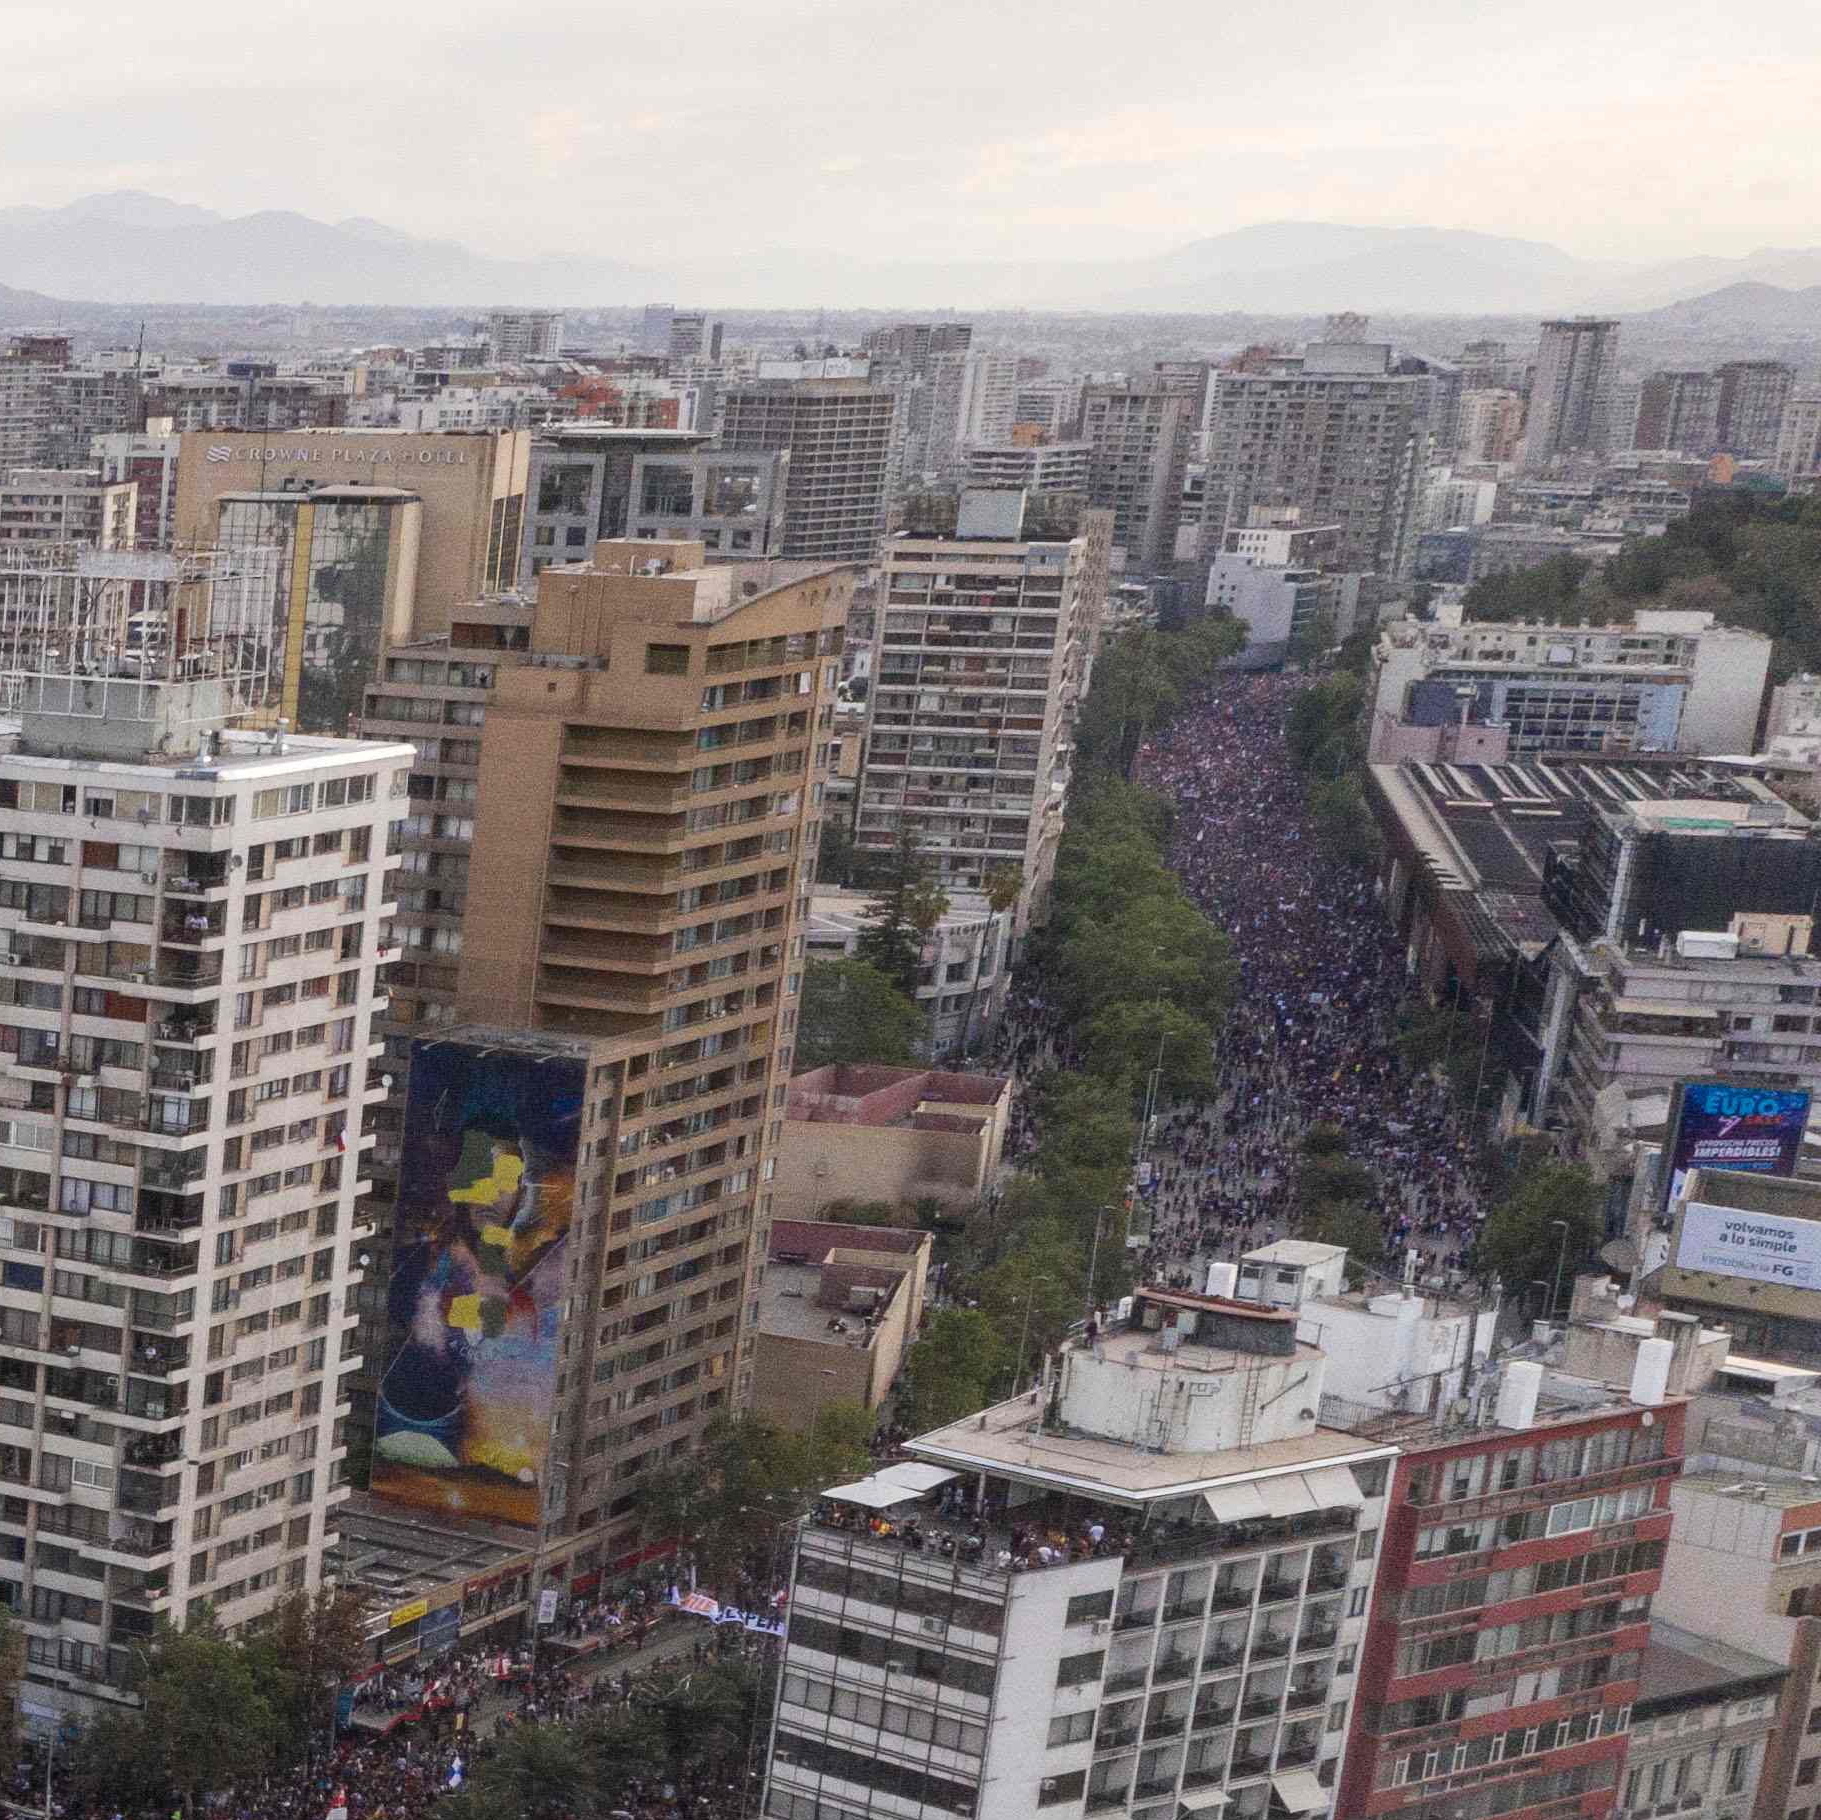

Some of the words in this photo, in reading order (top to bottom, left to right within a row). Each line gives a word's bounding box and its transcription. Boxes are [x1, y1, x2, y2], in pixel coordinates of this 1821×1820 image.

[235, 447, 320, 462] CROWNE
[333, 448, 392, 463] PLAZA
[405, 448, 467, 463] HOTEL
[1704, 1095, 1779, 1116] EURO
[1725, 1220, 1795, 1240] volvamos
[1719, 1233, 1727, 1243] a
[1731, 1231, 1745, 1245] lo
[1749, 1236, 1797, 1254] simple
[1773, 1264, 1795, 1277] FG
